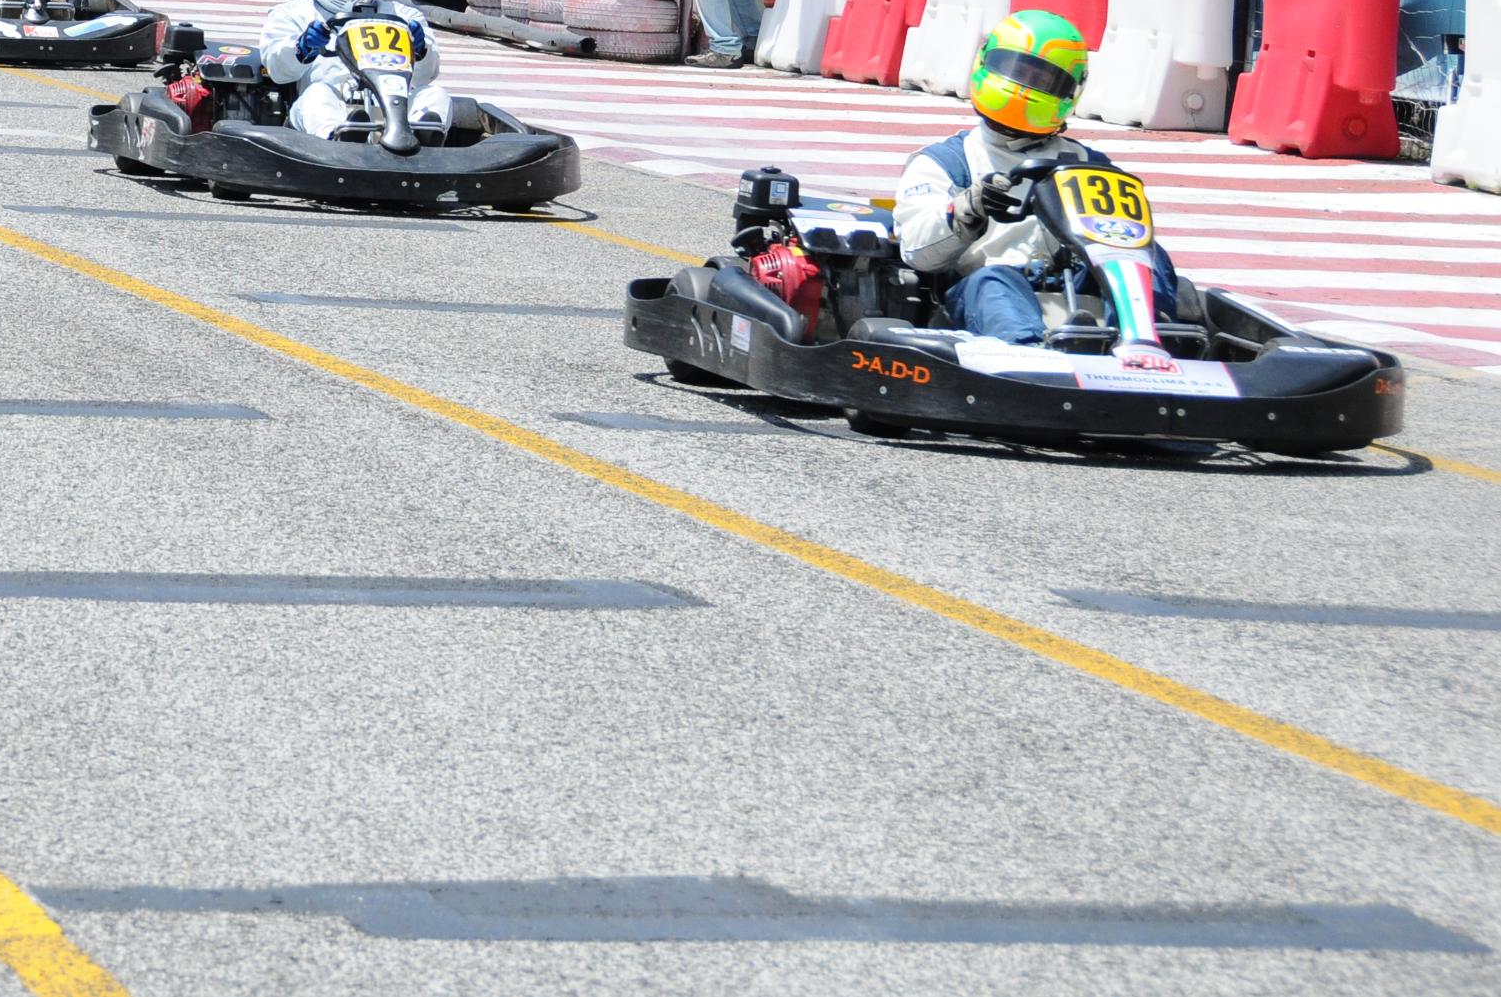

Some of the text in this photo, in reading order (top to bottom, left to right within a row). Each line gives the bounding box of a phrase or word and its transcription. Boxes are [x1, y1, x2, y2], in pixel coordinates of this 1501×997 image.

[359, 26, 404, 52] 52
[1061, 175, 1143, 221] 135
[1084, 374, 1188, 386] THERMOCLIMA
